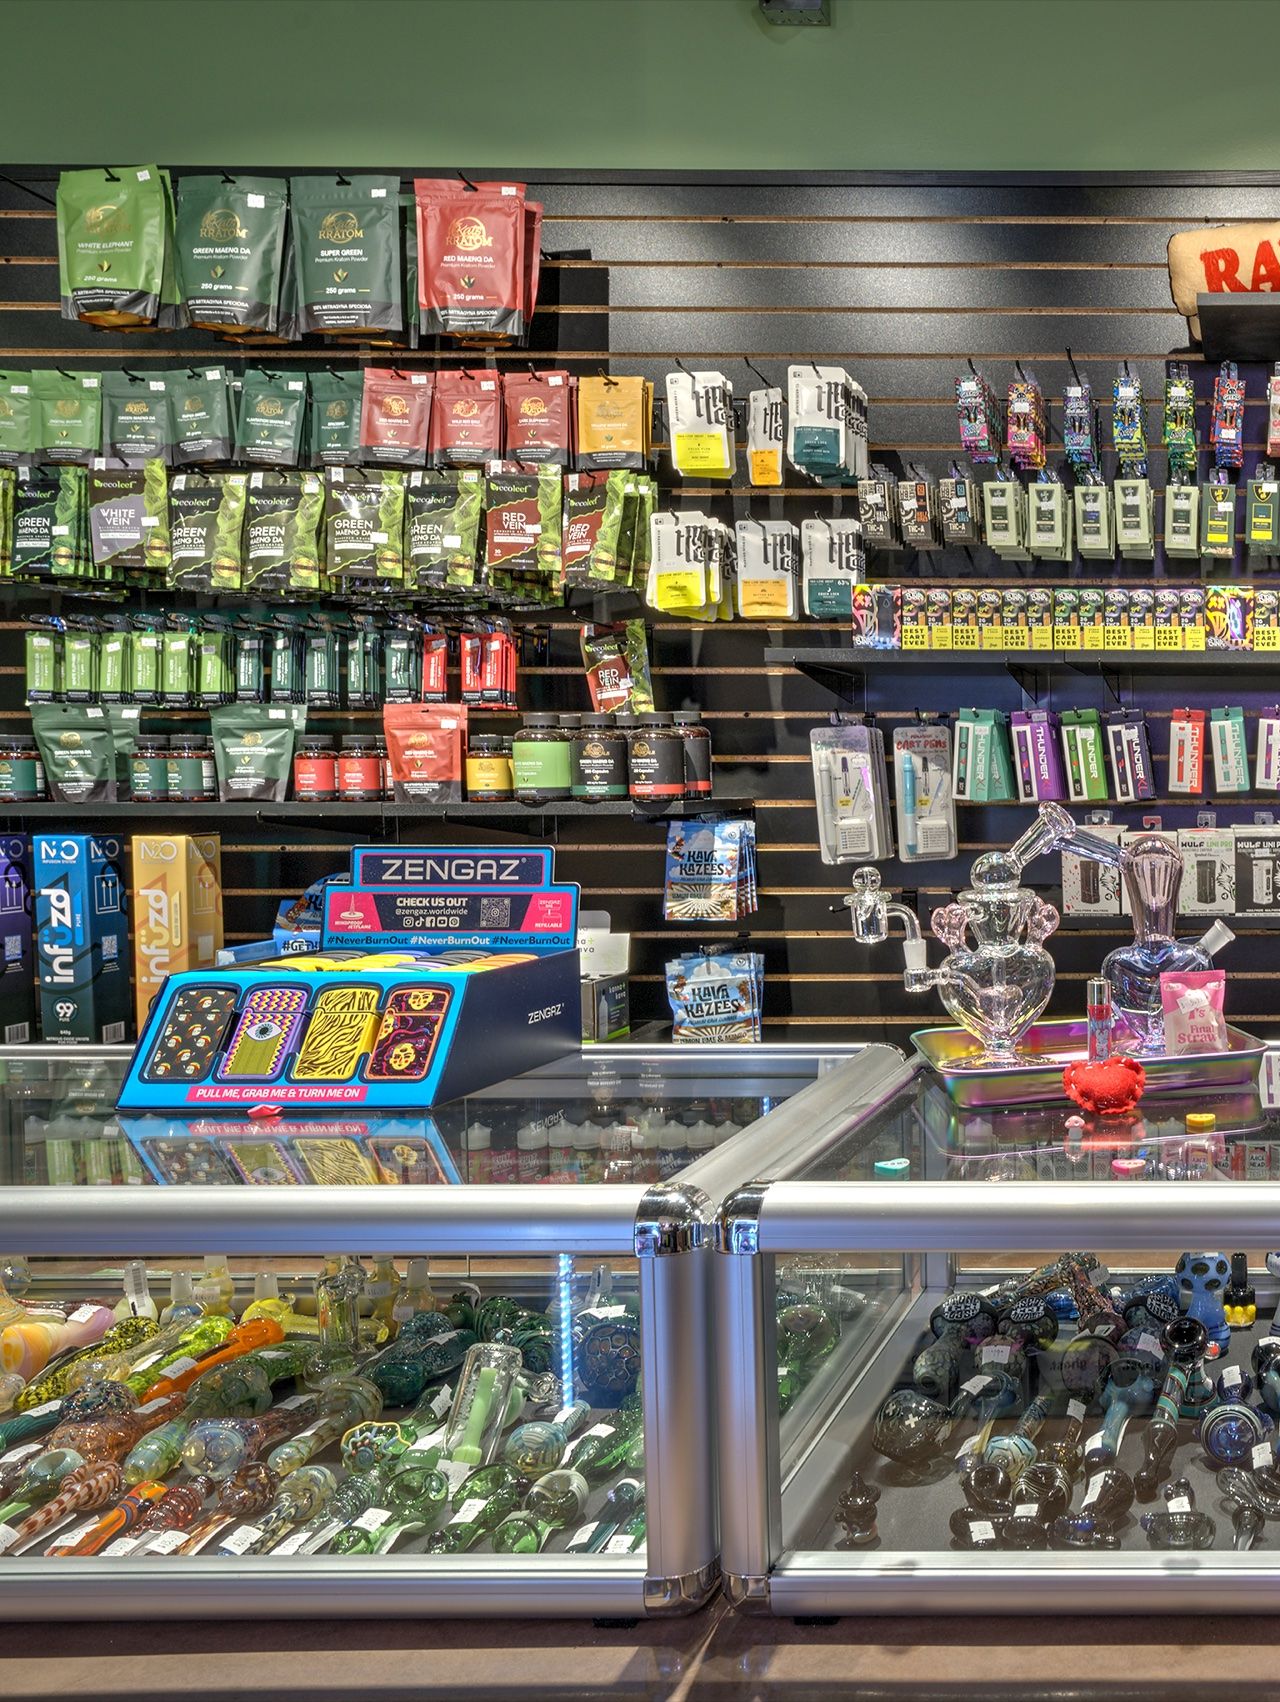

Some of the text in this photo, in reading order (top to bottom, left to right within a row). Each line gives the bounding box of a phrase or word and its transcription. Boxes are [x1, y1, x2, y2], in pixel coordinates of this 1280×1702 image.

[78, 240, 134, 249] WHITE ELEPHANT
[193, 247, 250, 255] GREEN MAENG DA
[214, 284, 232, 292] grams
[102, 479, 135, 489] ecoleef
[497, 483, 529, 493] ecoleef
[177, 498, 212, 507] ecoleef
[100, 509, 135, 518] WHITE
[502, 513, 526, 522] RED
[18, 518, 50, 527] GREEN
[335, 520, 373, 529] GREEN
[173, 528, 206, 538] GREEN
[250, 527, 284, 537] GREEN
[570, 524, 590, 532] RED
[908, 525, 924, 533] THC-A
[950, 524, 965, 532] THC-A
[569, 531, 587, 540] VEIN
[598, 669, 618, 678] RED
[1036, 726, 1050, 778] THUNDER
[1189, 727, 1199, 787] THUNDER
[1234, 724, 1244, 785] THUNDER
[687, 851, 718, 863] KAVA
[382, 859, 519, 880] ZENGAZ
[679, 863, 724, 876] KAZEES
[396, 897, 468, 907] CHECK US OUT
[395, 908, 468, 916] @zengaz.worldwide
[328, 936, 570, 946] #NeverBurnOut #NeverBurnOut #NeverBurnOut
[692, 984, 729, 1000] KAVA
[685, 1000, 739, 1018] KAZEES
[528, 1006, 562, 1024] ZENGAZ
[1190, 1025, 1214, 1034] Final
[1178, 1033, 1217, 1044] Straw
[196, 1088, 359, 1100] PULL ME, GRAB ME & TURN ME ON
